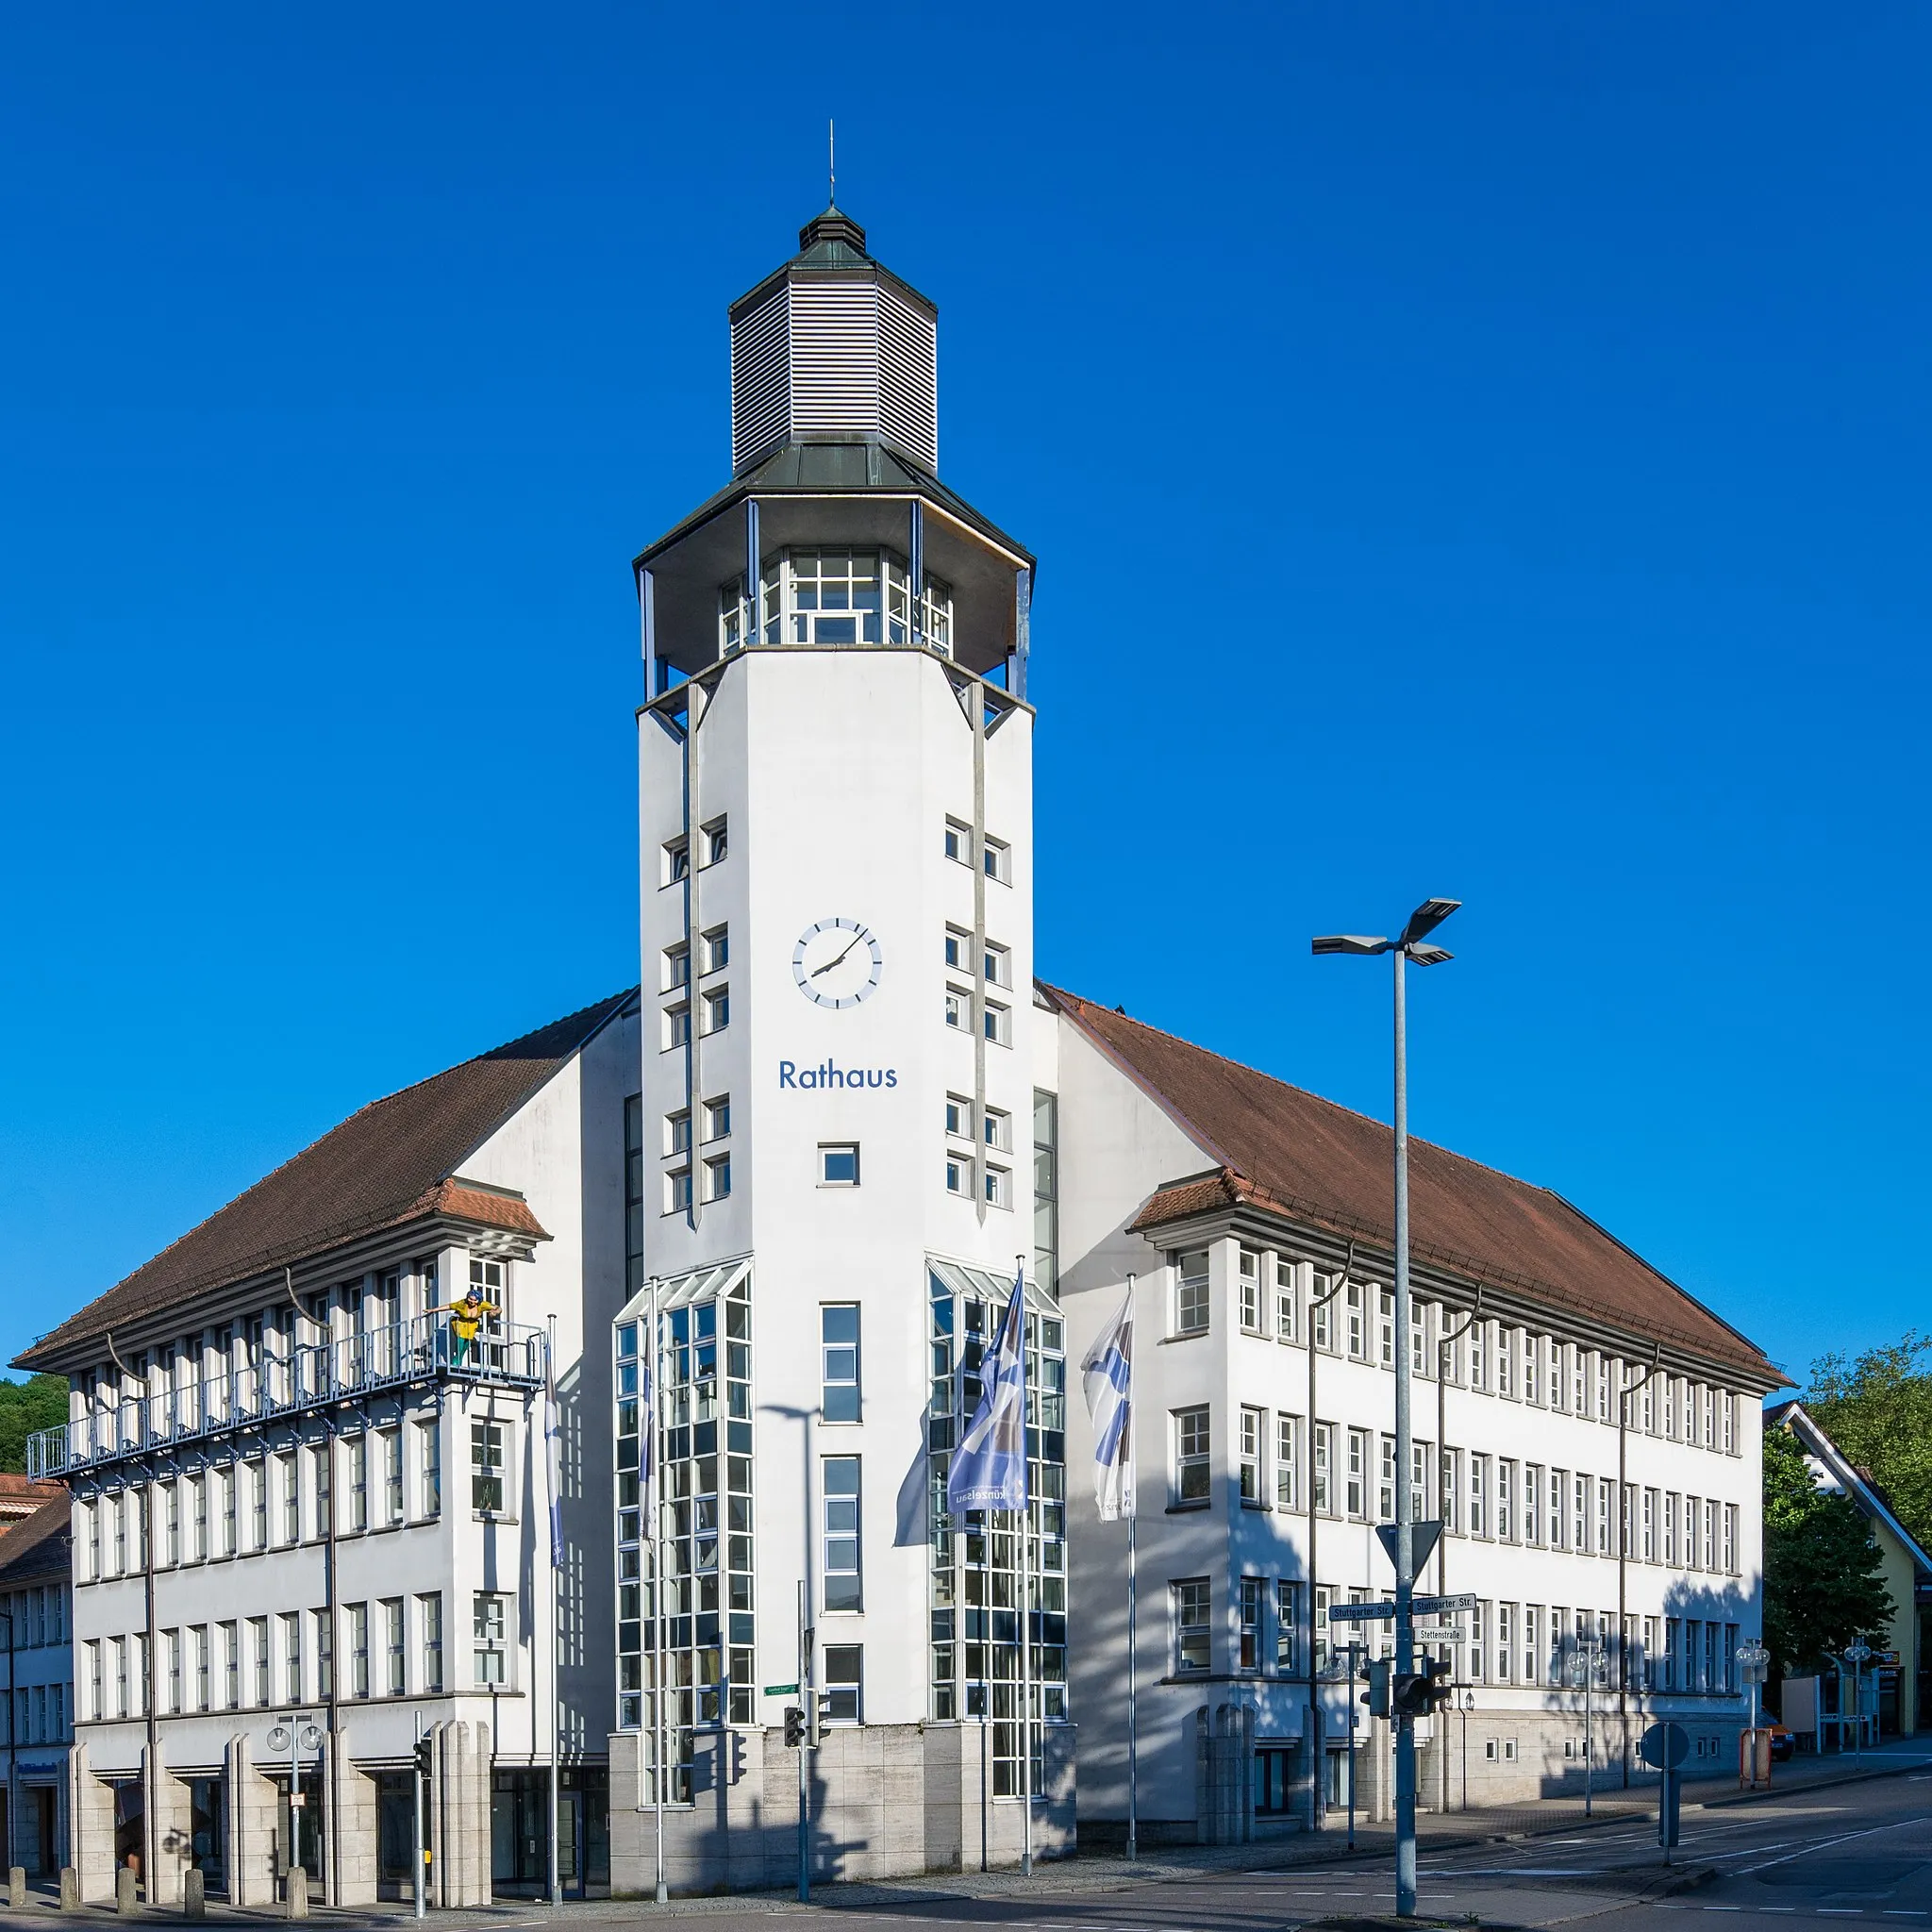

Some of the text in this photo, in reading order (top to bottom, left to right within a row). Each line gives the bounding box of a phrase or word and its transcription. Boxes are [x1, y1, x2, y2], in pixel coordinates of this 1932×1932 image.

[779, 1058, 898, 1090] Rathaus
[1417, 1597, 1472, 1611] Stuttgarter Str.
[1334, 1606, 1390, 1618] Stuttgarter Str.
[1421, 1630, 1460, 1640] Stettenstraße
